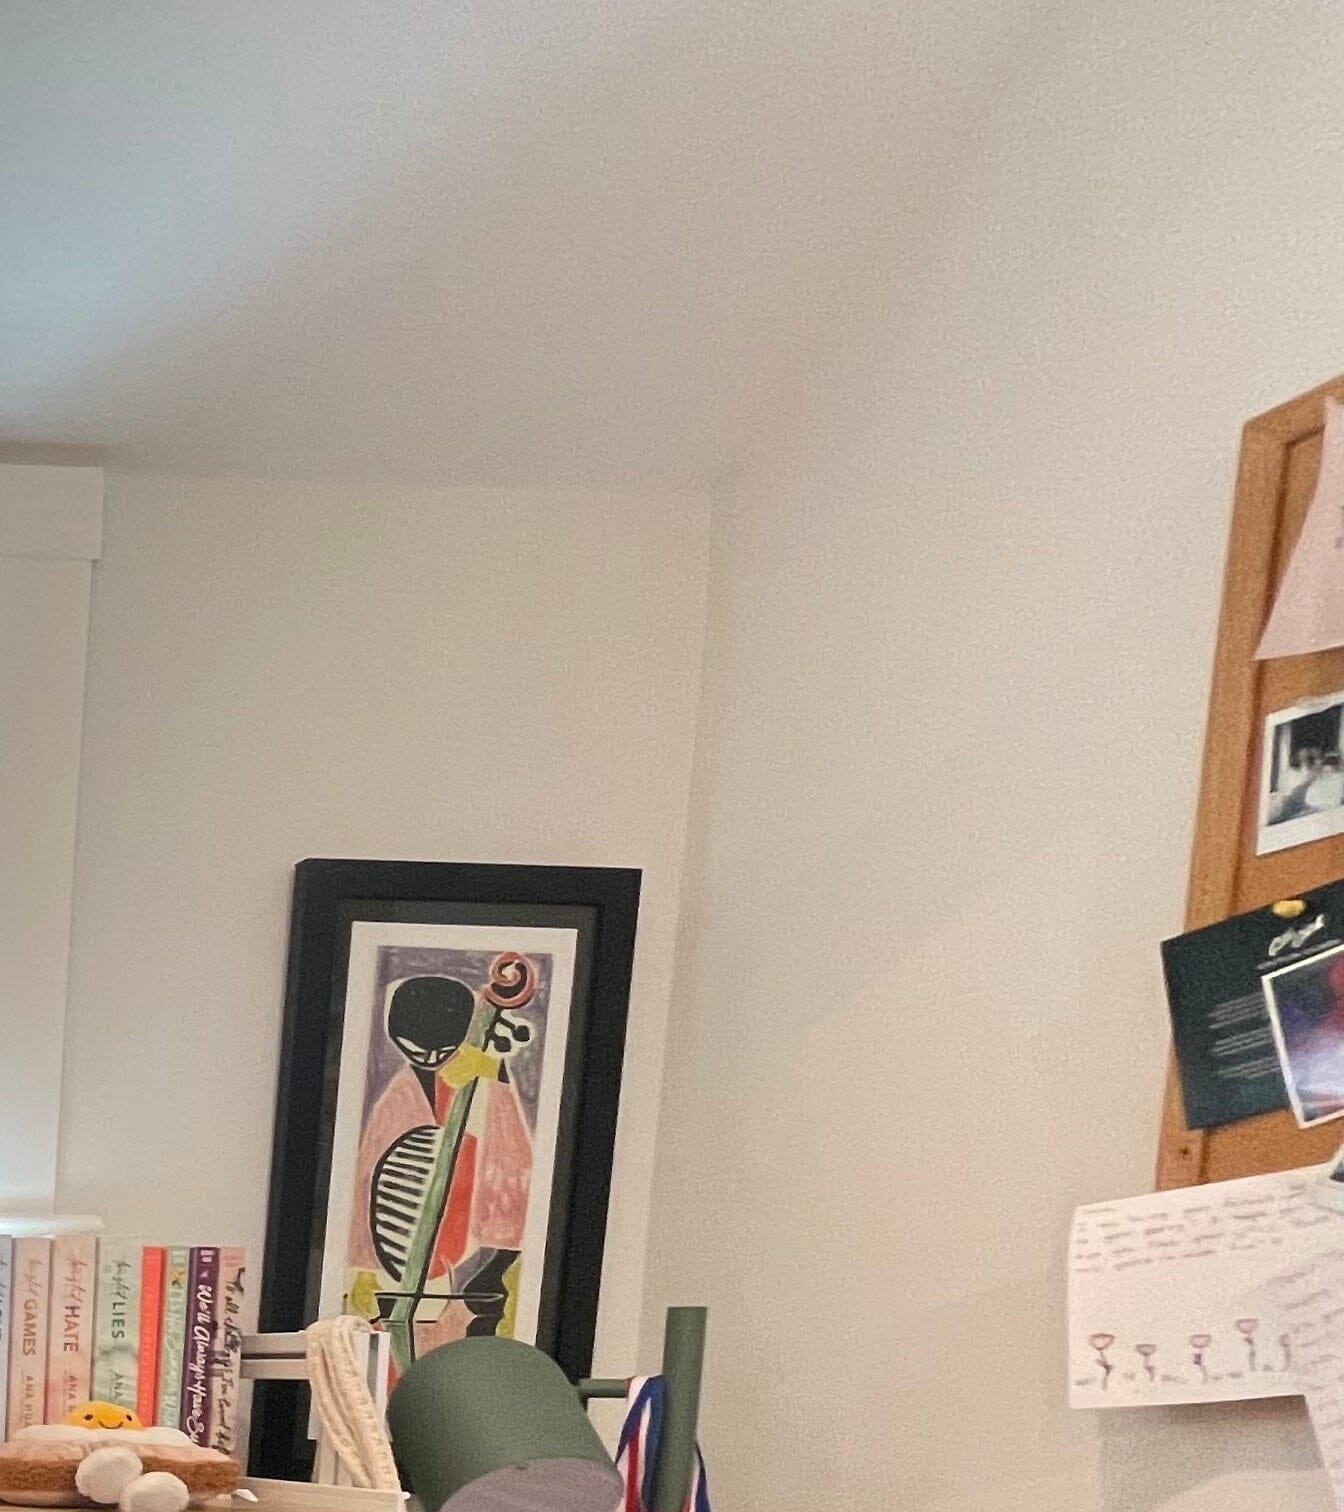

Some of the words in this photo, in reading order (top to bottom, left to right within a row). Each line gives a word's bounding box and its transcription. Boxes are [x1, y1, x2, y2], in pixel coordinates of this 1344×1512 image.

[23, 1299, 37, 1356] GAMES
[63, 1305, 80, 1353] HATE
[111, 1302, 125, 1339] LIES
[24, 1375, 35, 1401] ANA
[67, 1375, 78, 1401] ANA
[113, 1372, 124, 1397] ANA
